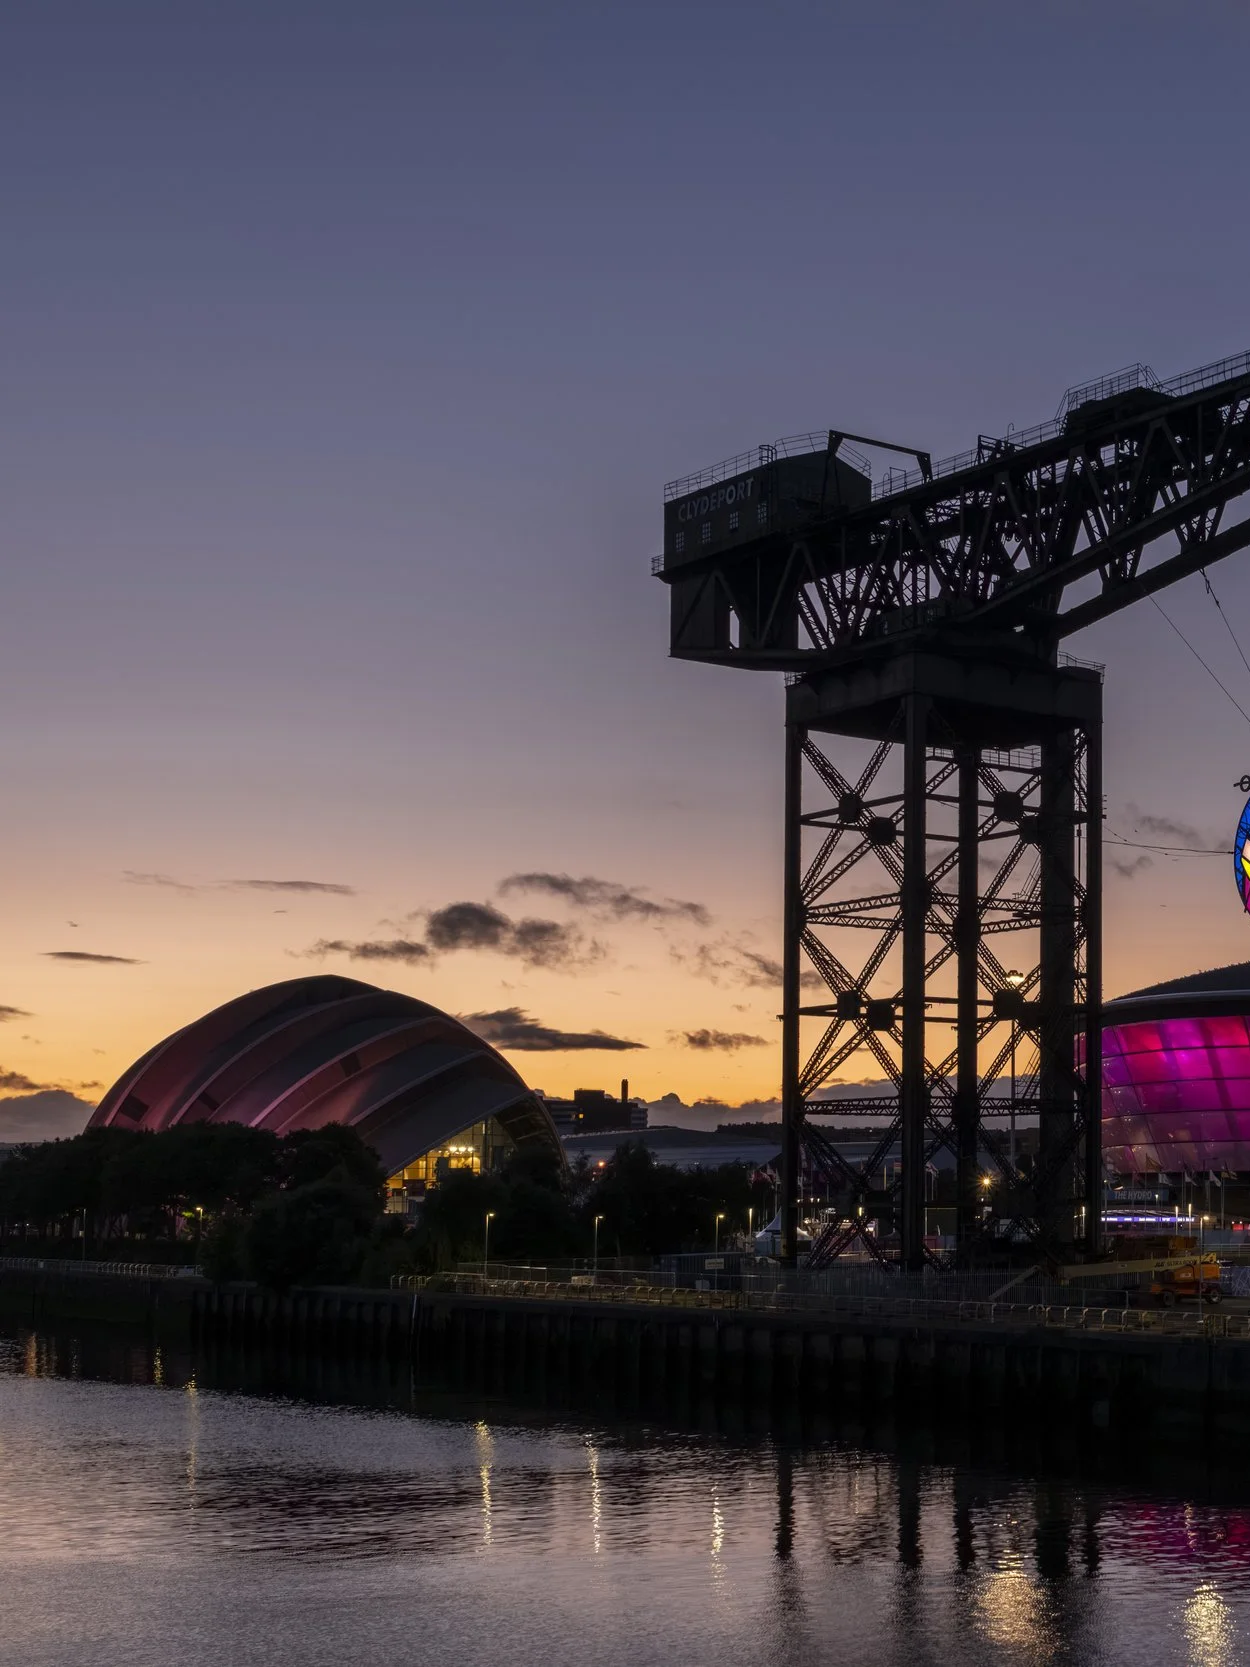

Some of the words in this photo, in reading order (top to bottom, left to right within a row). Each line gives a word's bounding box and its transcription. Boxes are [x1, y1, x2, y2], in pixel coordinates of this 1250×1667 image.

[678, 476, 755, 522] CLYDEPORT
[1114, 1190, 1127, 1200] THE
[1128, 1190, 1152, 1200] HYDRO
